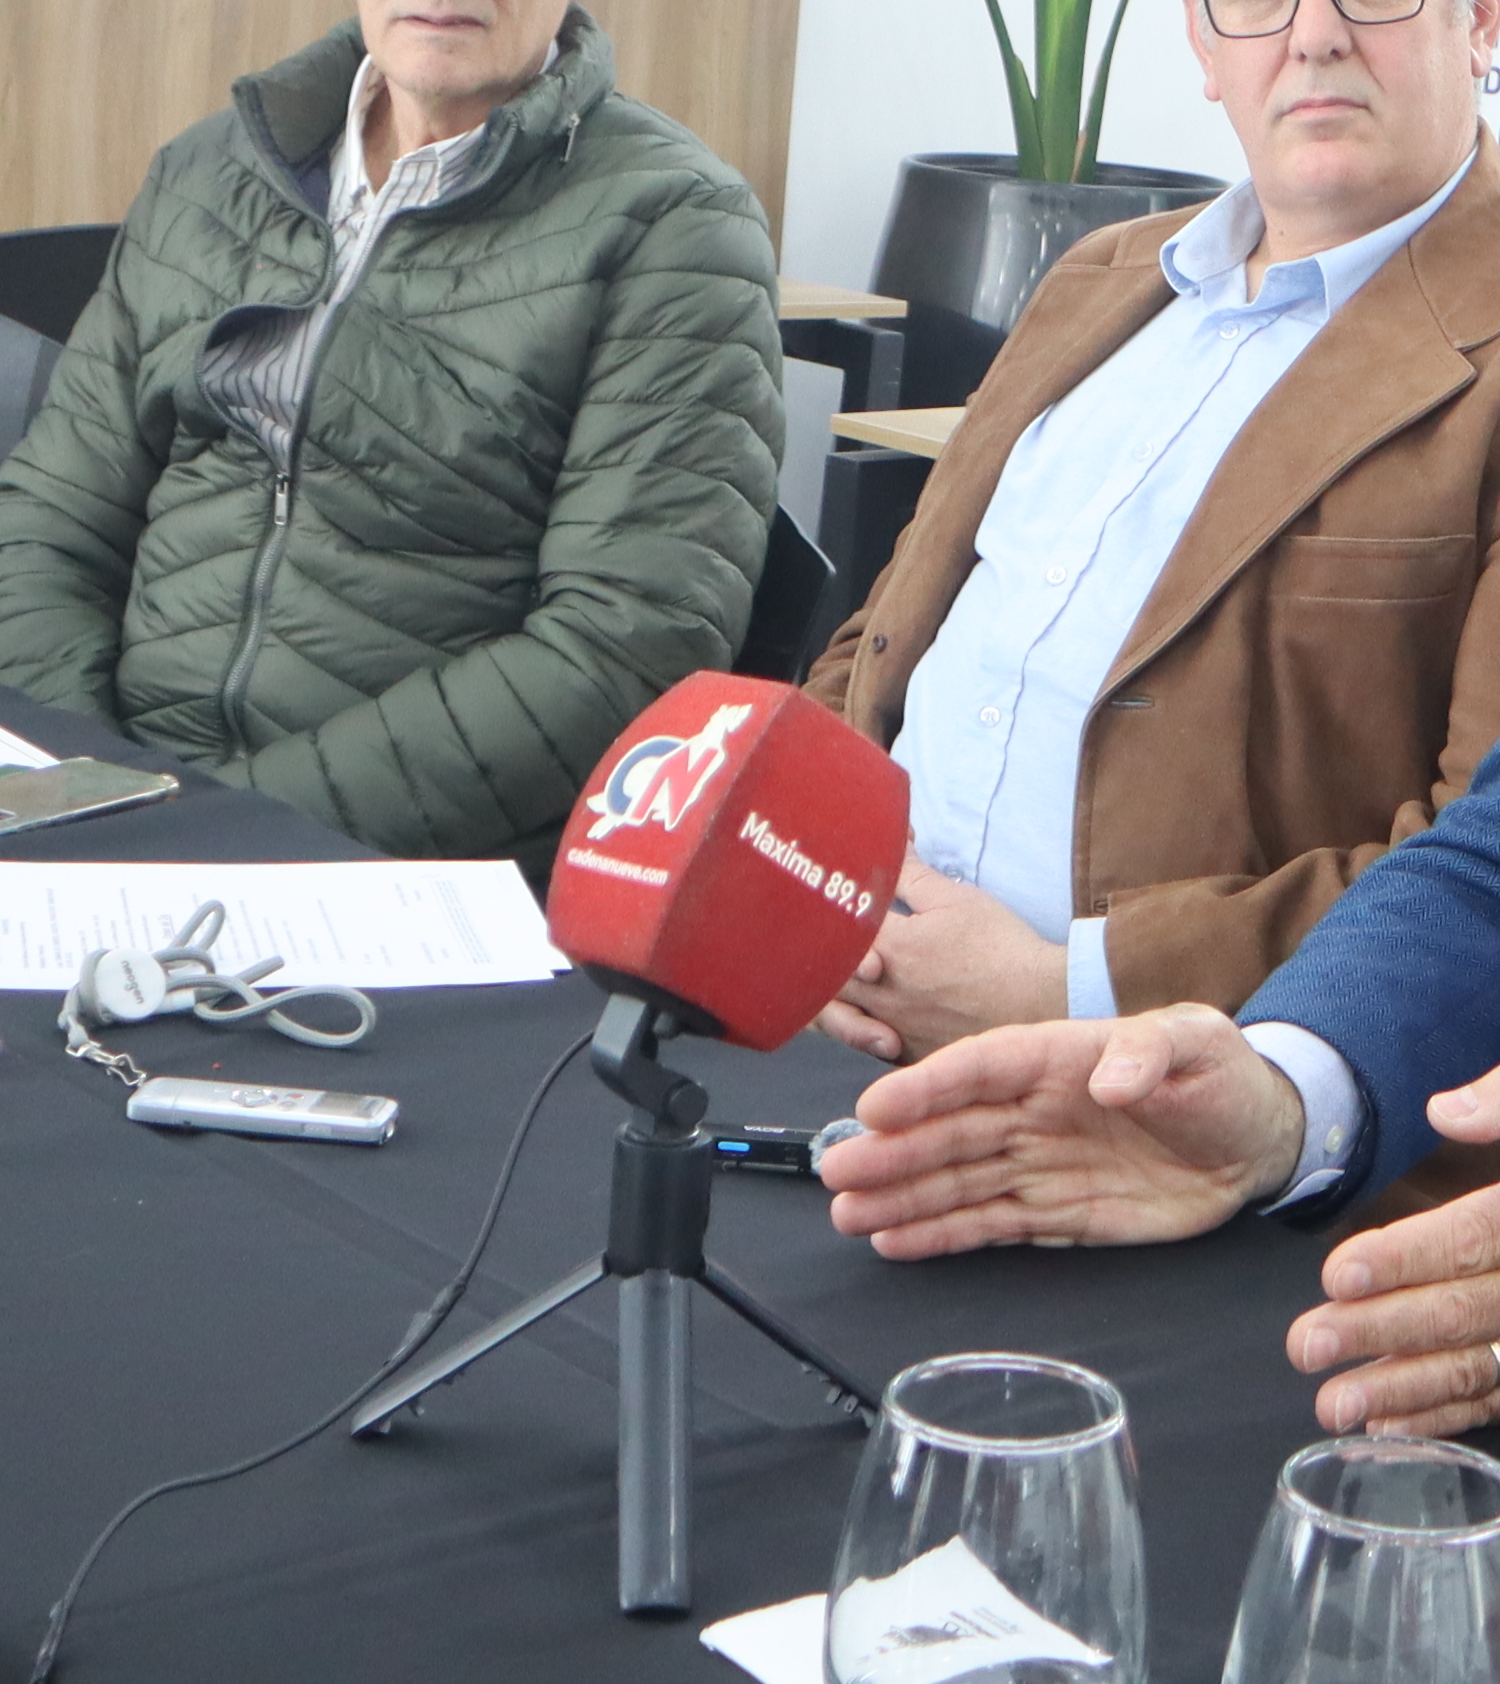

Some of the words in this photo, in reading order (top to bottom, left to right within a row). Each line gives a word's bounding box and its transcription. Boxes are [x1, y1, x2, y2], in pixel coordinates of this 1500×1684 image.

[566, 846, 669, 887] cadenanueve.com
[740, 811, 825, 888] Maxima
[823, 869, 873, 918] 89.9
[121, 959, 145, 1005] neogen
